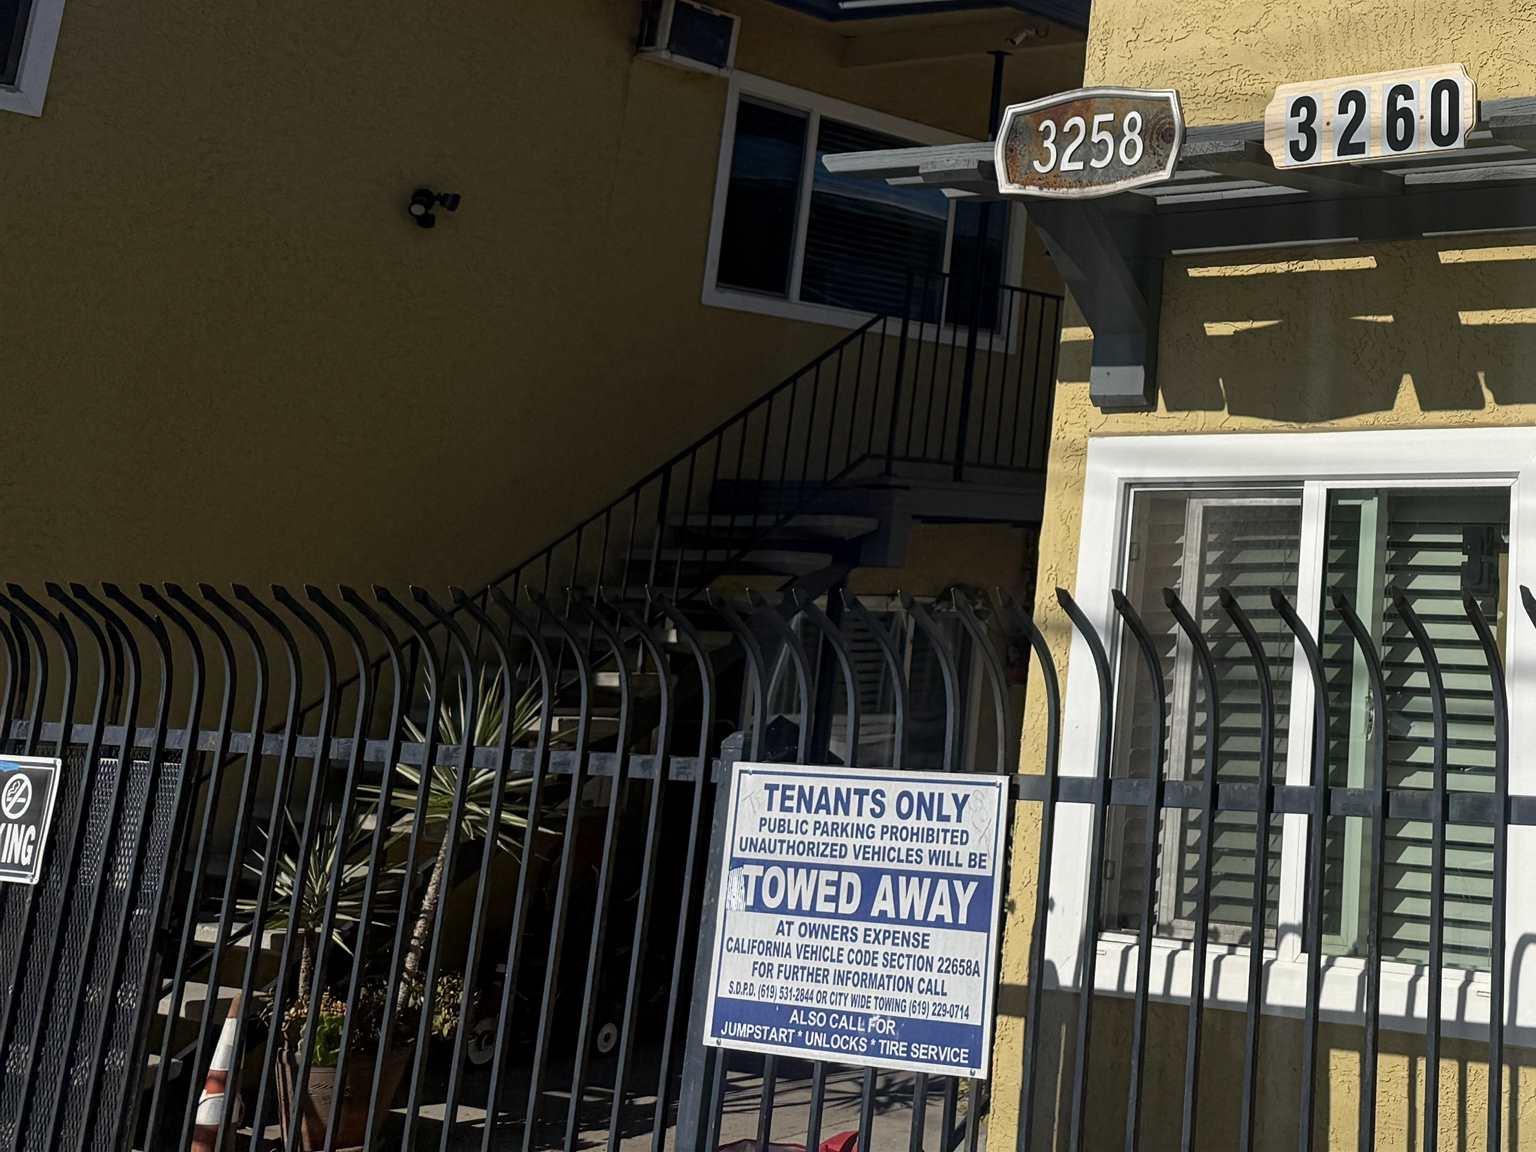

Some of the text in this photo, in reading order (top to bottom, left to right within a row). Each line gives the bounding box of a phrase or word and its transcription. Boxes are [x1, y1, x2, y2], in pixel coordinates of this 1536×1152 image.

[1289, 78, 1461, 163] 3260
[1033, 110, 1144, 173] 3258
[764, 783, 970, 823] TENANTS ONLY
[759, 817, 969, 846] PUBLIC PARKING PROHIBITED
[739, 836, 987, 870] UNAUTHORIZED VEHICLES WILL BE
[742, 865, 979, 924] TOWED AWAY
[776, 920, 931, 949] AT OWNERS EXPENSE
[726, 938, 981, 978] CALIFORNIA VEHICLE CODE SECTION 22658A
[752, 961, 948, 997] FOR FURTHER INFORMATION CALL
[728, 981, 970, 1020] S.D.P.D. (619) 531-2844 OR CITY WIDE TOWING (619) 229-0714
[789, 1009, 896, 1035] ALSO CALL FOR
[720, 1021, 969, 1064] JUMPSTART UNLOCKS TIRE SERVICE
